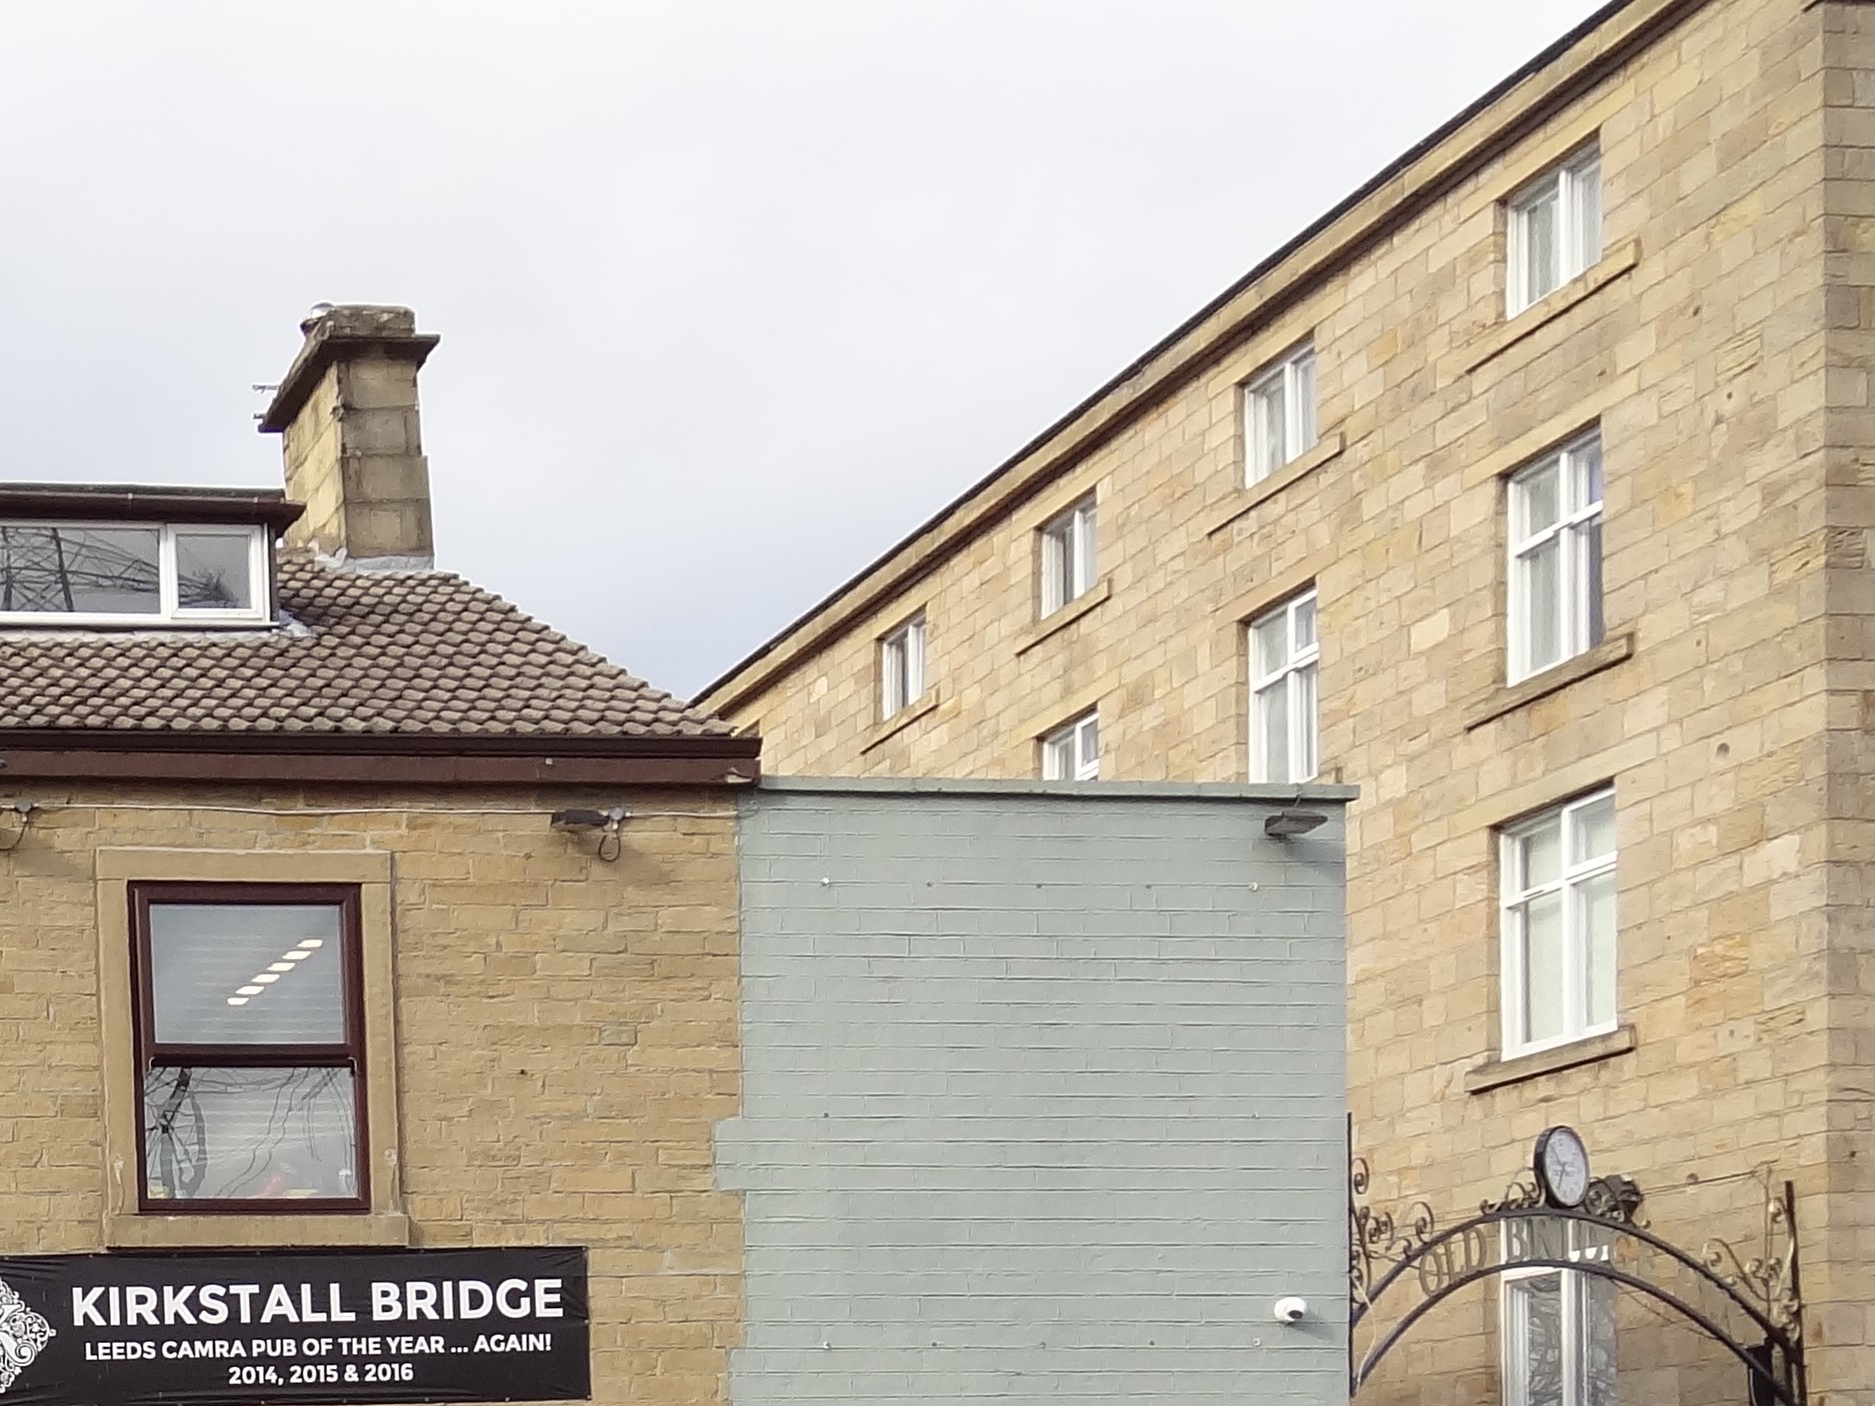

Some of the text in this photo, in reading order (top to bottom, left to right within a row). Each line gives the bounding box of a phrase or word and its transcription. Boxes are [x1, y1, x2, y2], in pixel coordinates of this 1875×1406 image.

[1419, 1227, 1486, 1297] OLD
[73, 1279, 563, 1326] KIRKSTALL BRIDGE
[86, 1342, 155, 1360] LEEDS
[162, 1340, 246, 1358] CAMRA
[252, 1339, 296, 1356] PUB
[303, 1338, 332, 1355] OF
[338, 1337, 381, 1355] THE
[386, 1336, 445, 1354] YEAR
[474, 1334, 551, 1352] AGAIN!
[229, 1363, 413, 1385] 2014, 2015 & 2016
